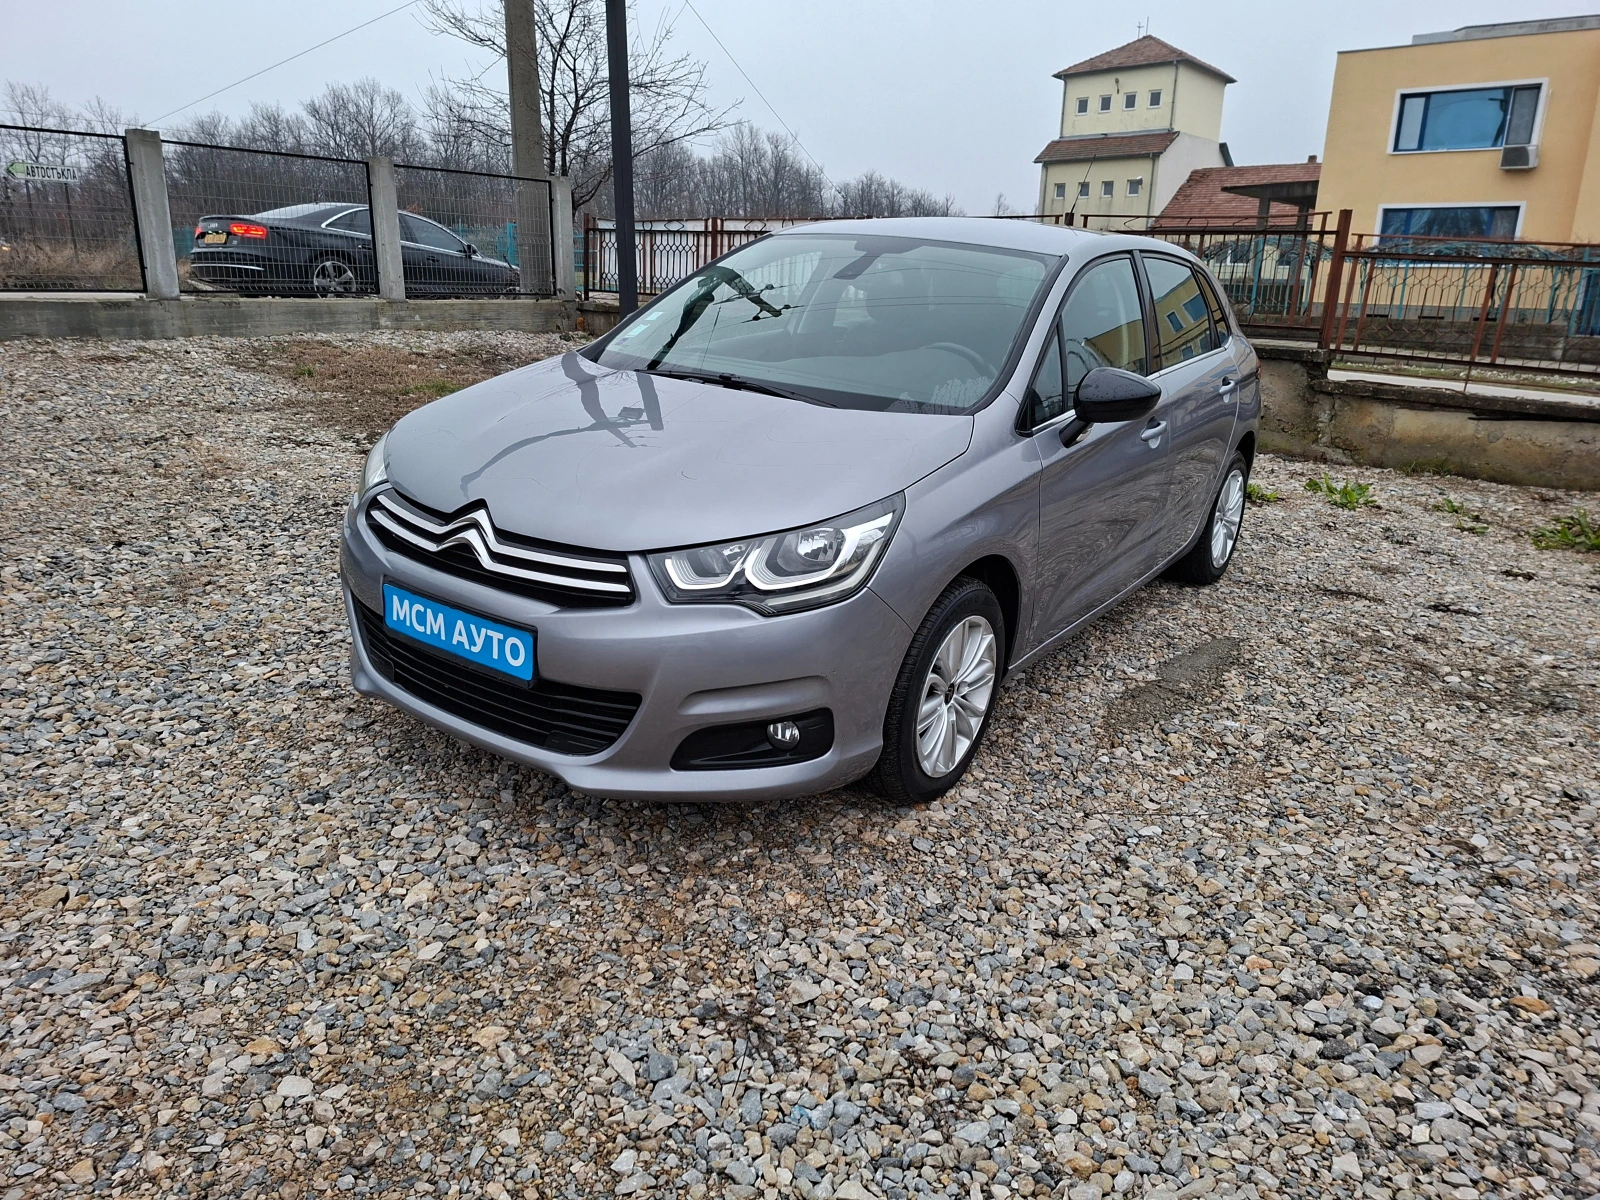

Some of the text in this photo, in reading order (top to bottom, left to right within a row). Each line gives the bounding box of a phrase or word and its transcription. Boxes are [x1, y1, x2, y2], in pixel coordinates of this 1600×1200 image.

[26, 165, 78, 181] АВТОСТЪКЛА
[392, 594, 526, 667] МСМ АУТО
